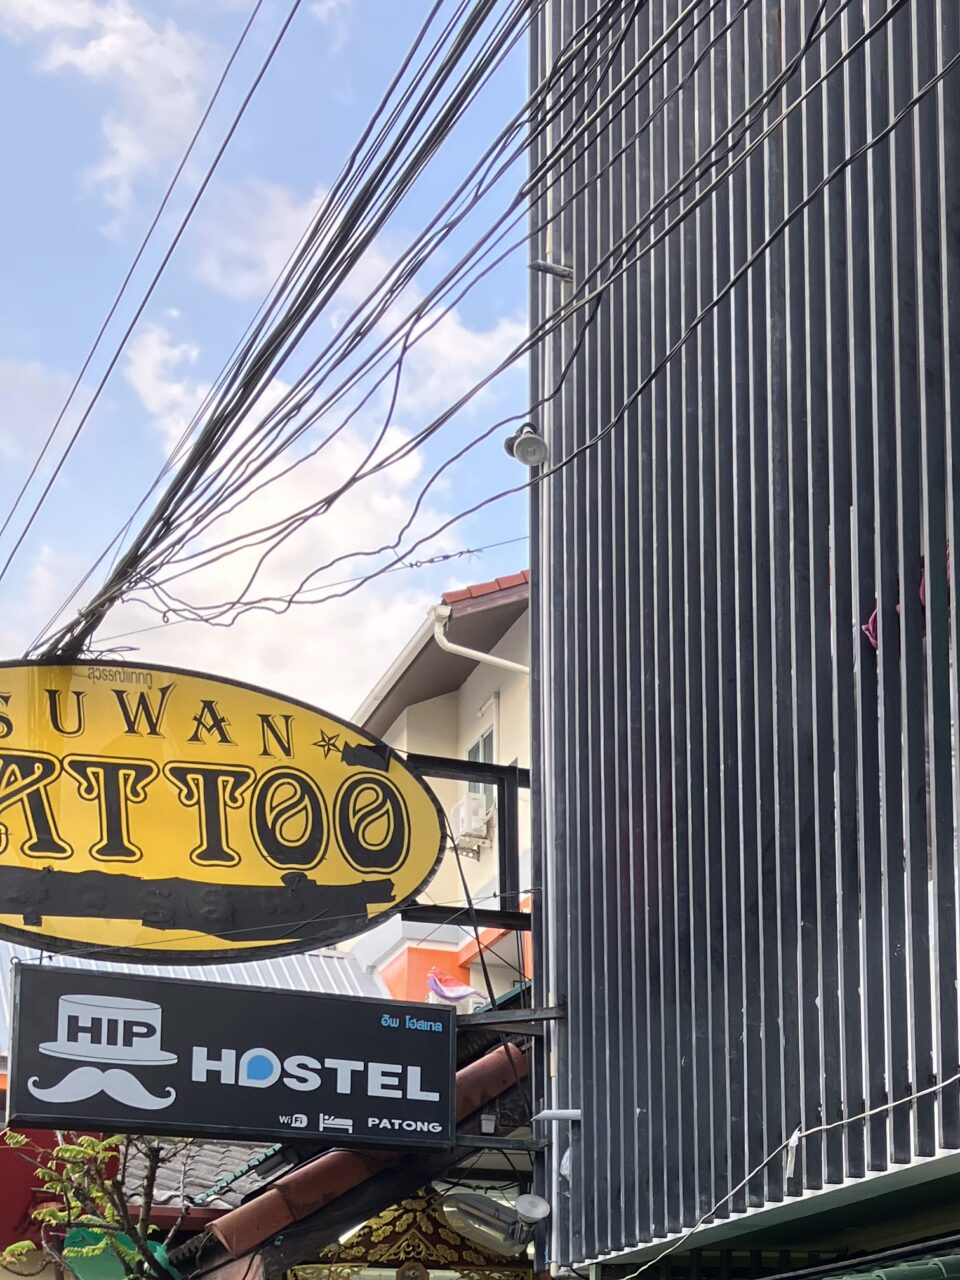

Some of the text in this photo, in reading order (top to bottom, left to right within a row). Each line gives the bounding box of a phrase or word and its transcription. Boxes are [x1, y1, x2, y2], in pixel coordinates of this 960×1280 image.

[66, 1014, 157, 1048] HIP
[191, 1045, 441, 1103] HOSTEL
[367, 1117, 443, 1133] PATONG
